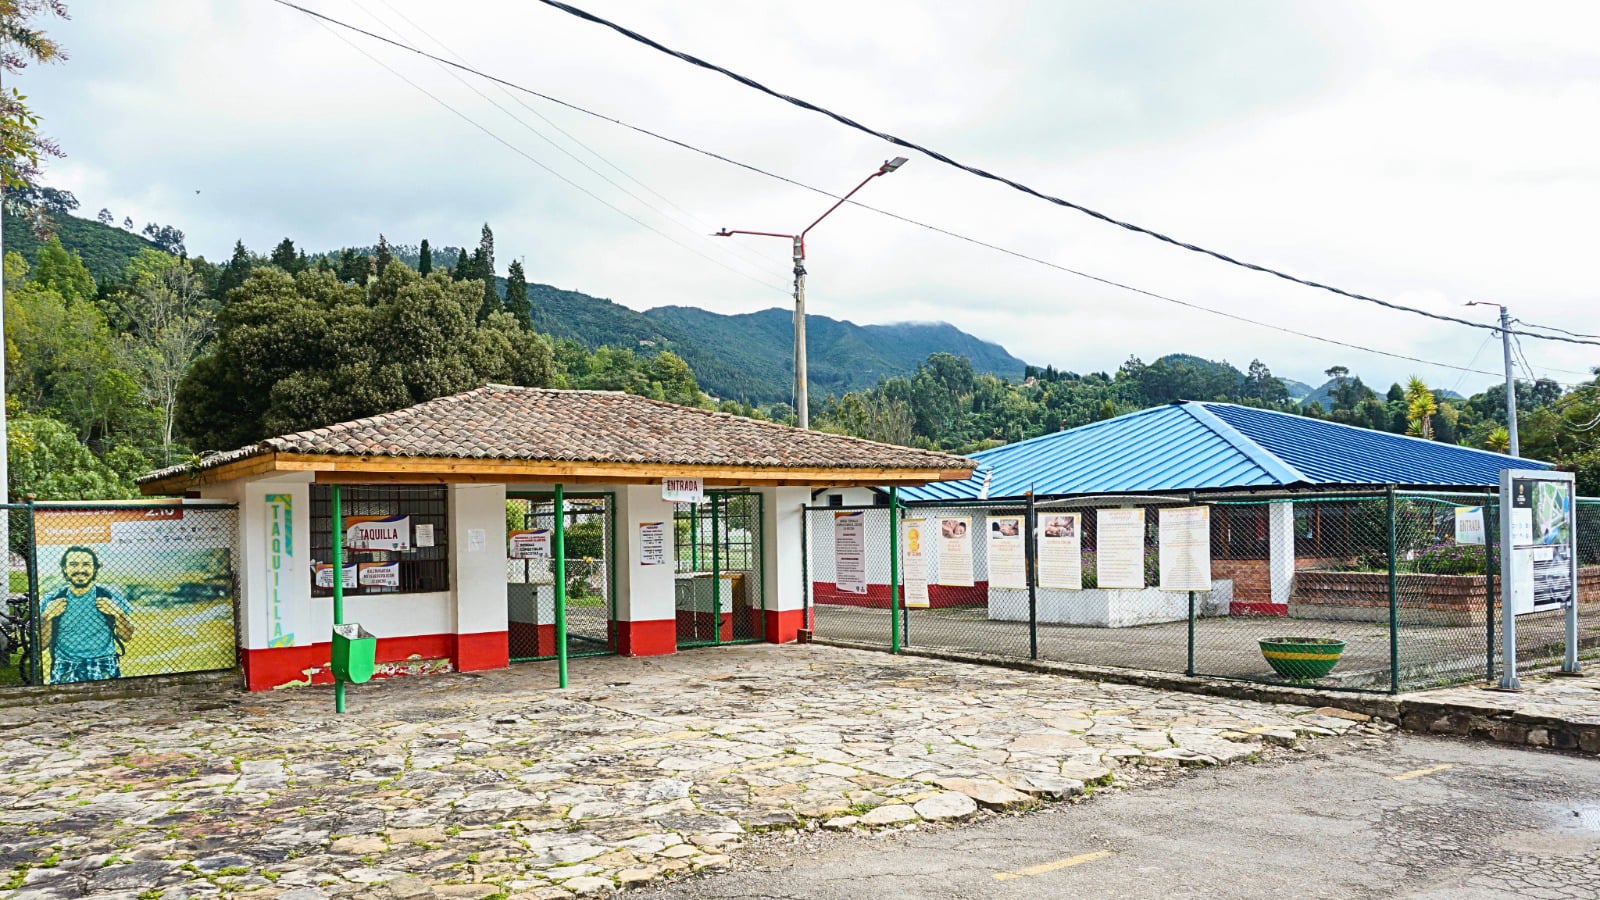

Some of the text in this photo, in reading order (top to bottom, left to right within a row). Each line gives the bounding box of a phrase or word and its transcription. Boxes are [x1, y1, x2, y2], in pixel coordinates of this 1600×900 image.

[667, 480, 698, 491] ENTRADA
[1459, 519, 1481, 532] ENTRADA
[359, 528, 398, 541] TAQUILLA
[271, 504, 283, 637] TAQUILLA
